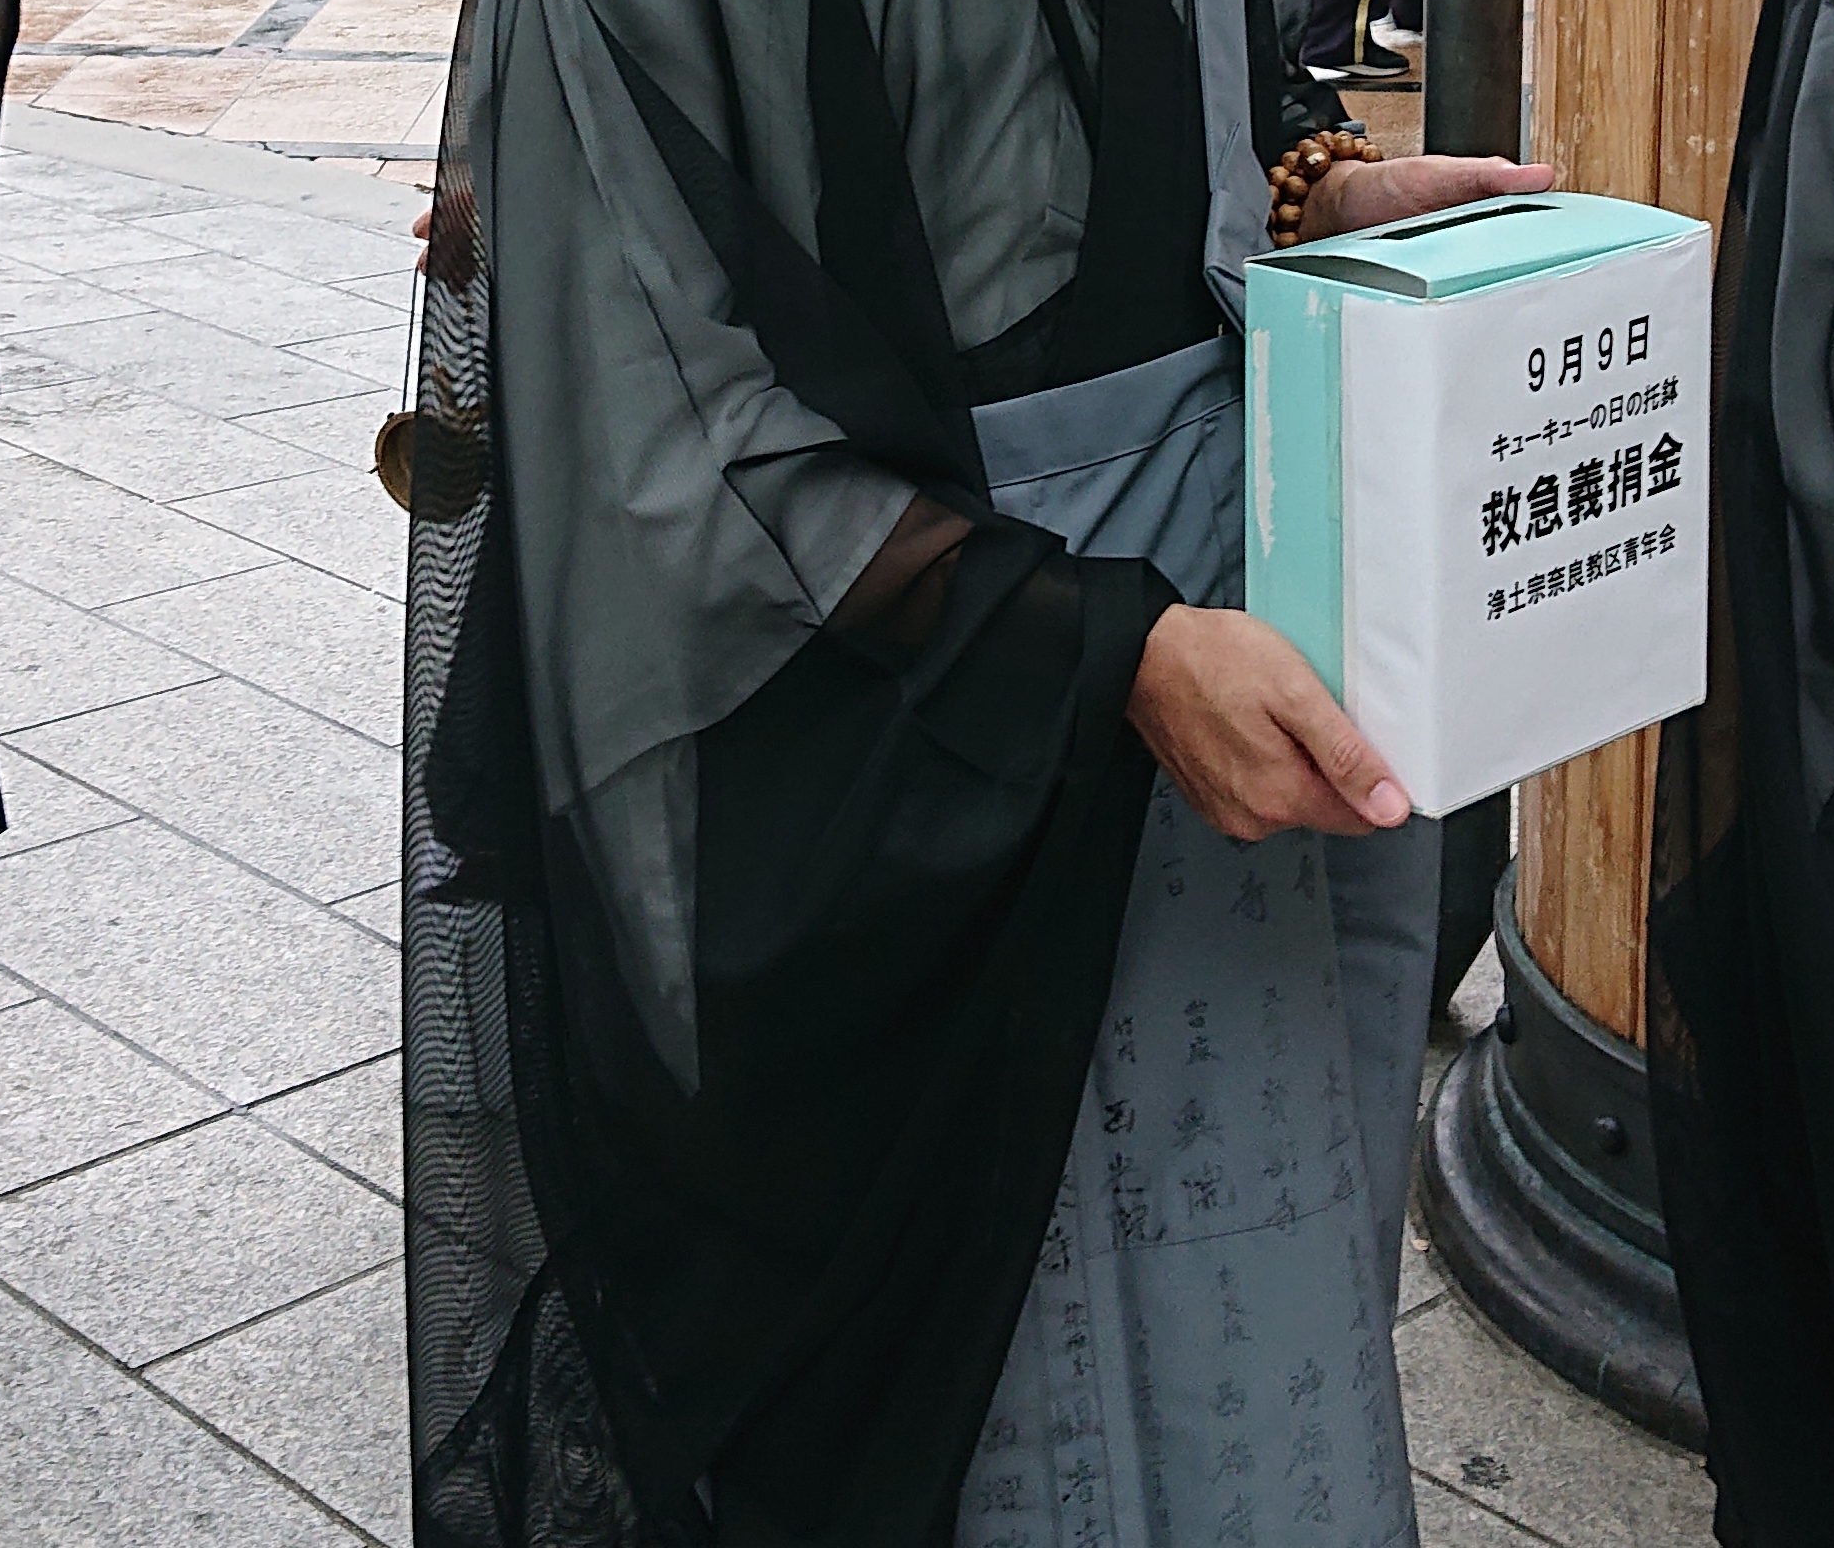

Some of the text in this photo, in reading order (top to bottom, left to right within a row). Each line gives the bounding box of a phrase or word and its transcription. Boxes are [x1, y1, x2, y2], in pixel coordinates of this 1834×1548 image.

[1527, 314, 1651, 392] 9月9日
[1491, 375, 1680, 462] キューキューの日の托鉢
[1481, 431, 1684, 558] 救急義捐金
[1486, 523, 1677, 622] 浄土宗奈良教区青年会
